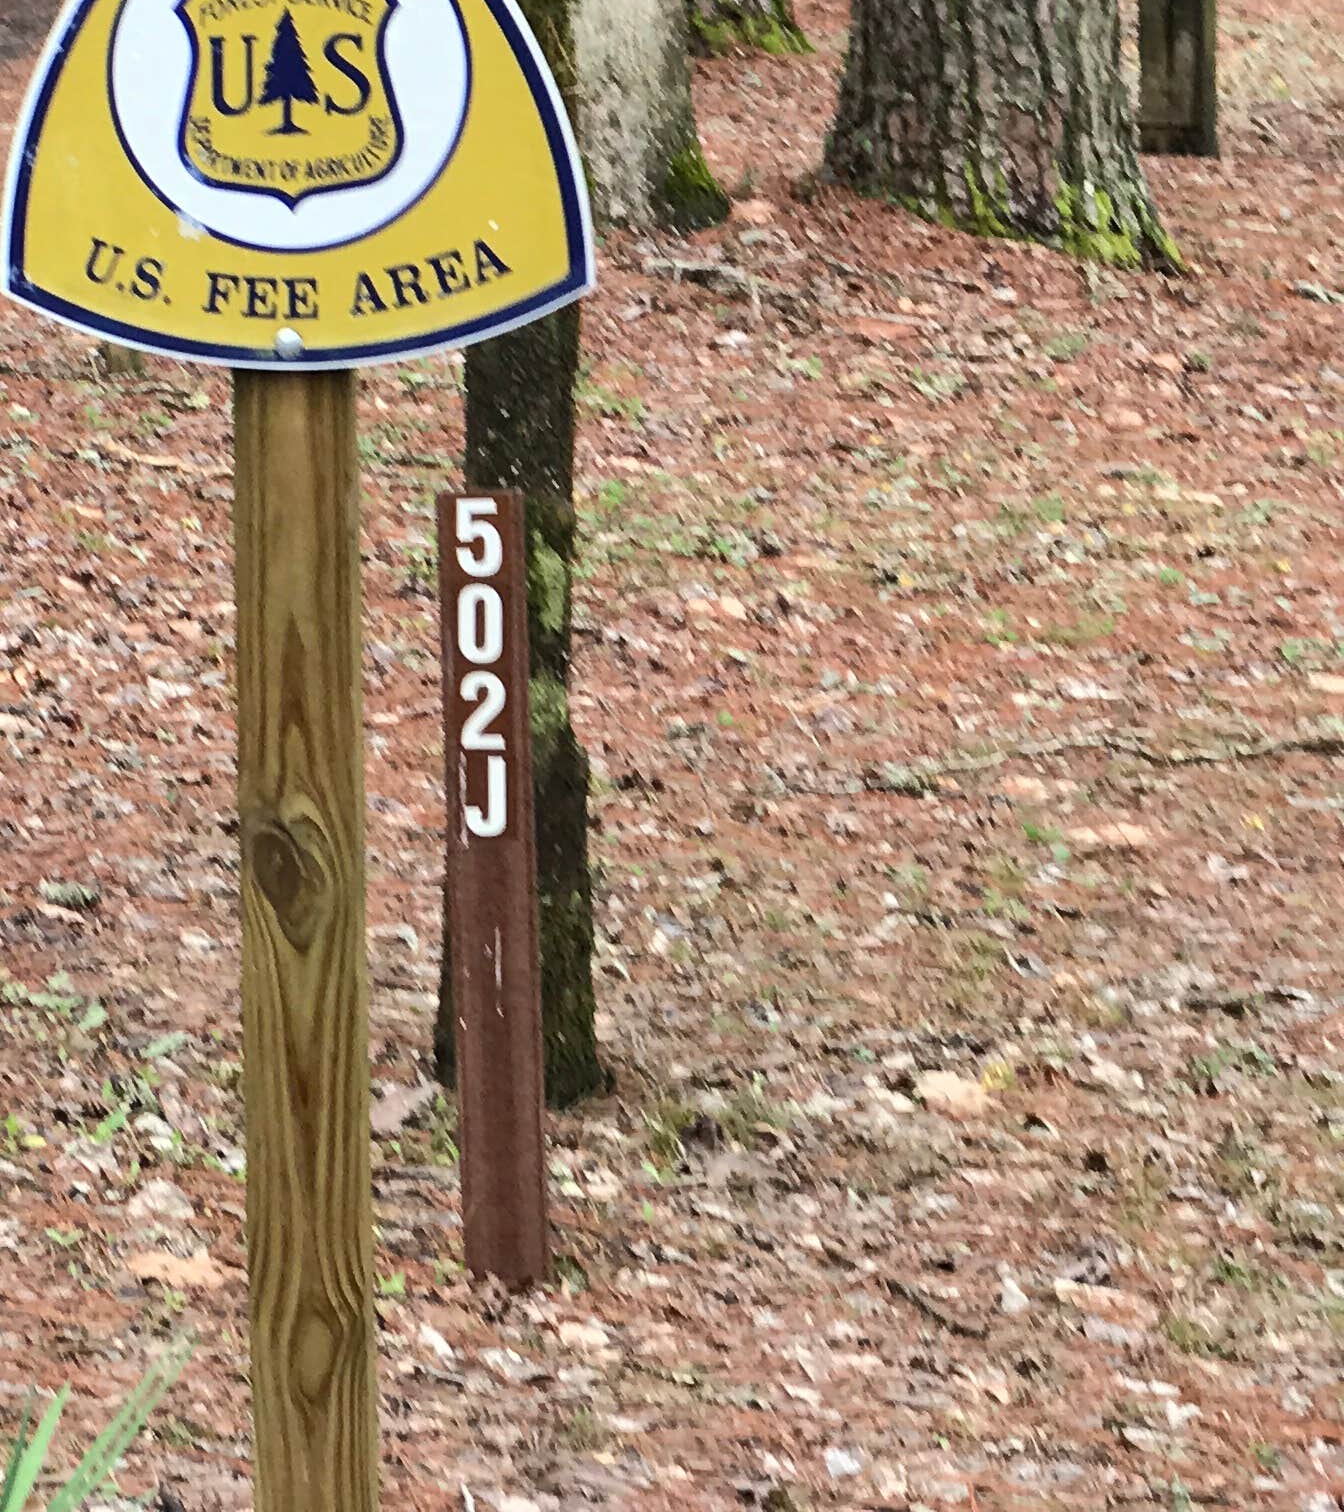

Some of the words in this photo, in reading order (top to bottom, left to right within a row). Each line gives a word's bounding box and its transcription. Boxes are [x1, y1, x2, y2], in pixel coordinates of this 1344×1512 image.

[84, 236, 173, 306] U.S.
[201, 270, 320, 320] FEE
[349, 237, 513, 318] AREA
